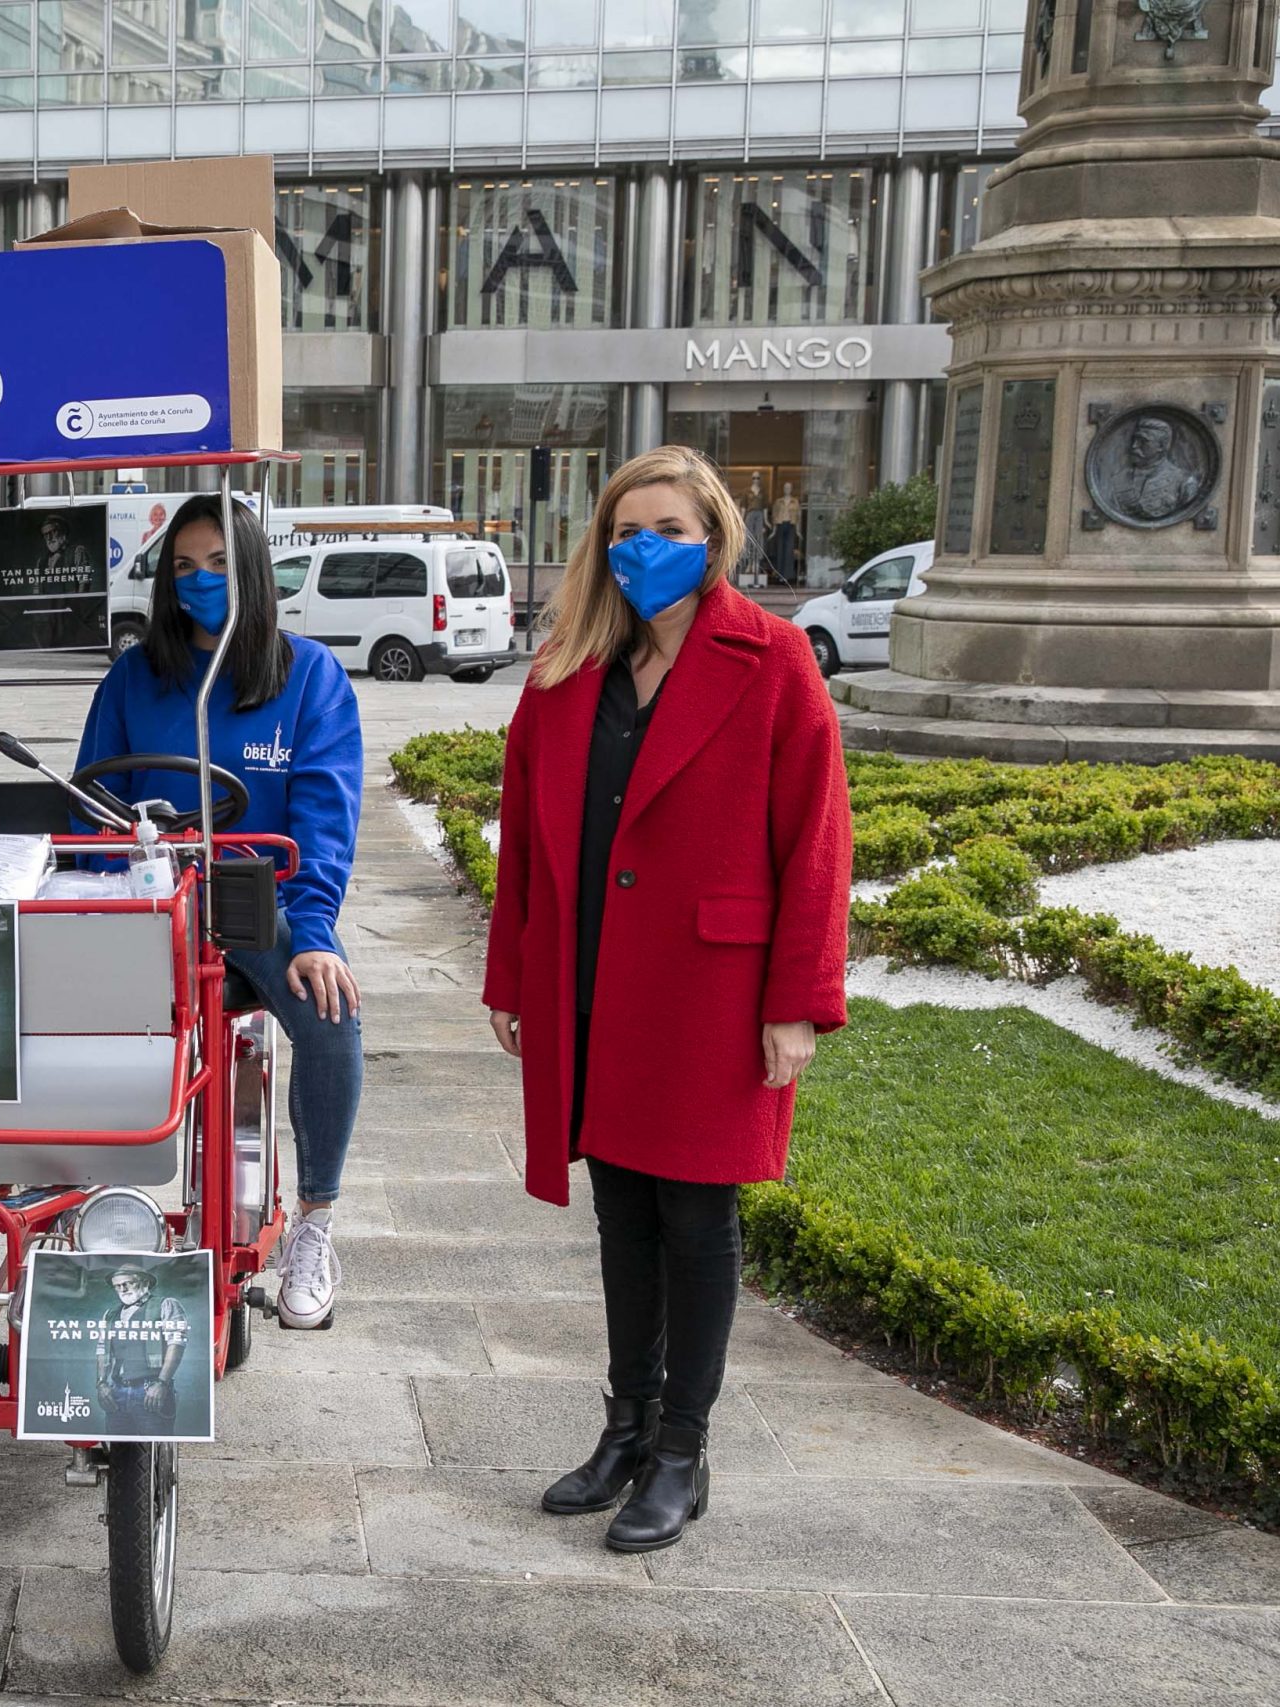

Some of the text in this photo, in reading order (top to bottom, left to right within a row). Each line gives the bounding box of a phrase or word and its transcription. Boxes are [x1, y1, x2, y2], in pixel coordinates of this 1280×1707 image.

[686, 337, 873, 372] MANGO
[98, 411, 148, 422] Ayuntamiento
[149, 409, 159, 417] de
[167, 407, 193, 416] Coruña
[98, 417, 166, 428] Concello da Coruña
[1, 565, 95, 577] TAN DE SIEMPRE.
[3, 574, 93, 586] TAN DIFERENTE.
[243, 746, 293, 763] OBELISC
[47, 1320, 192, 1330] TAN DE SIEMPRE.
[50, 1330, 188, 1342] TAN DIFERENTE.
